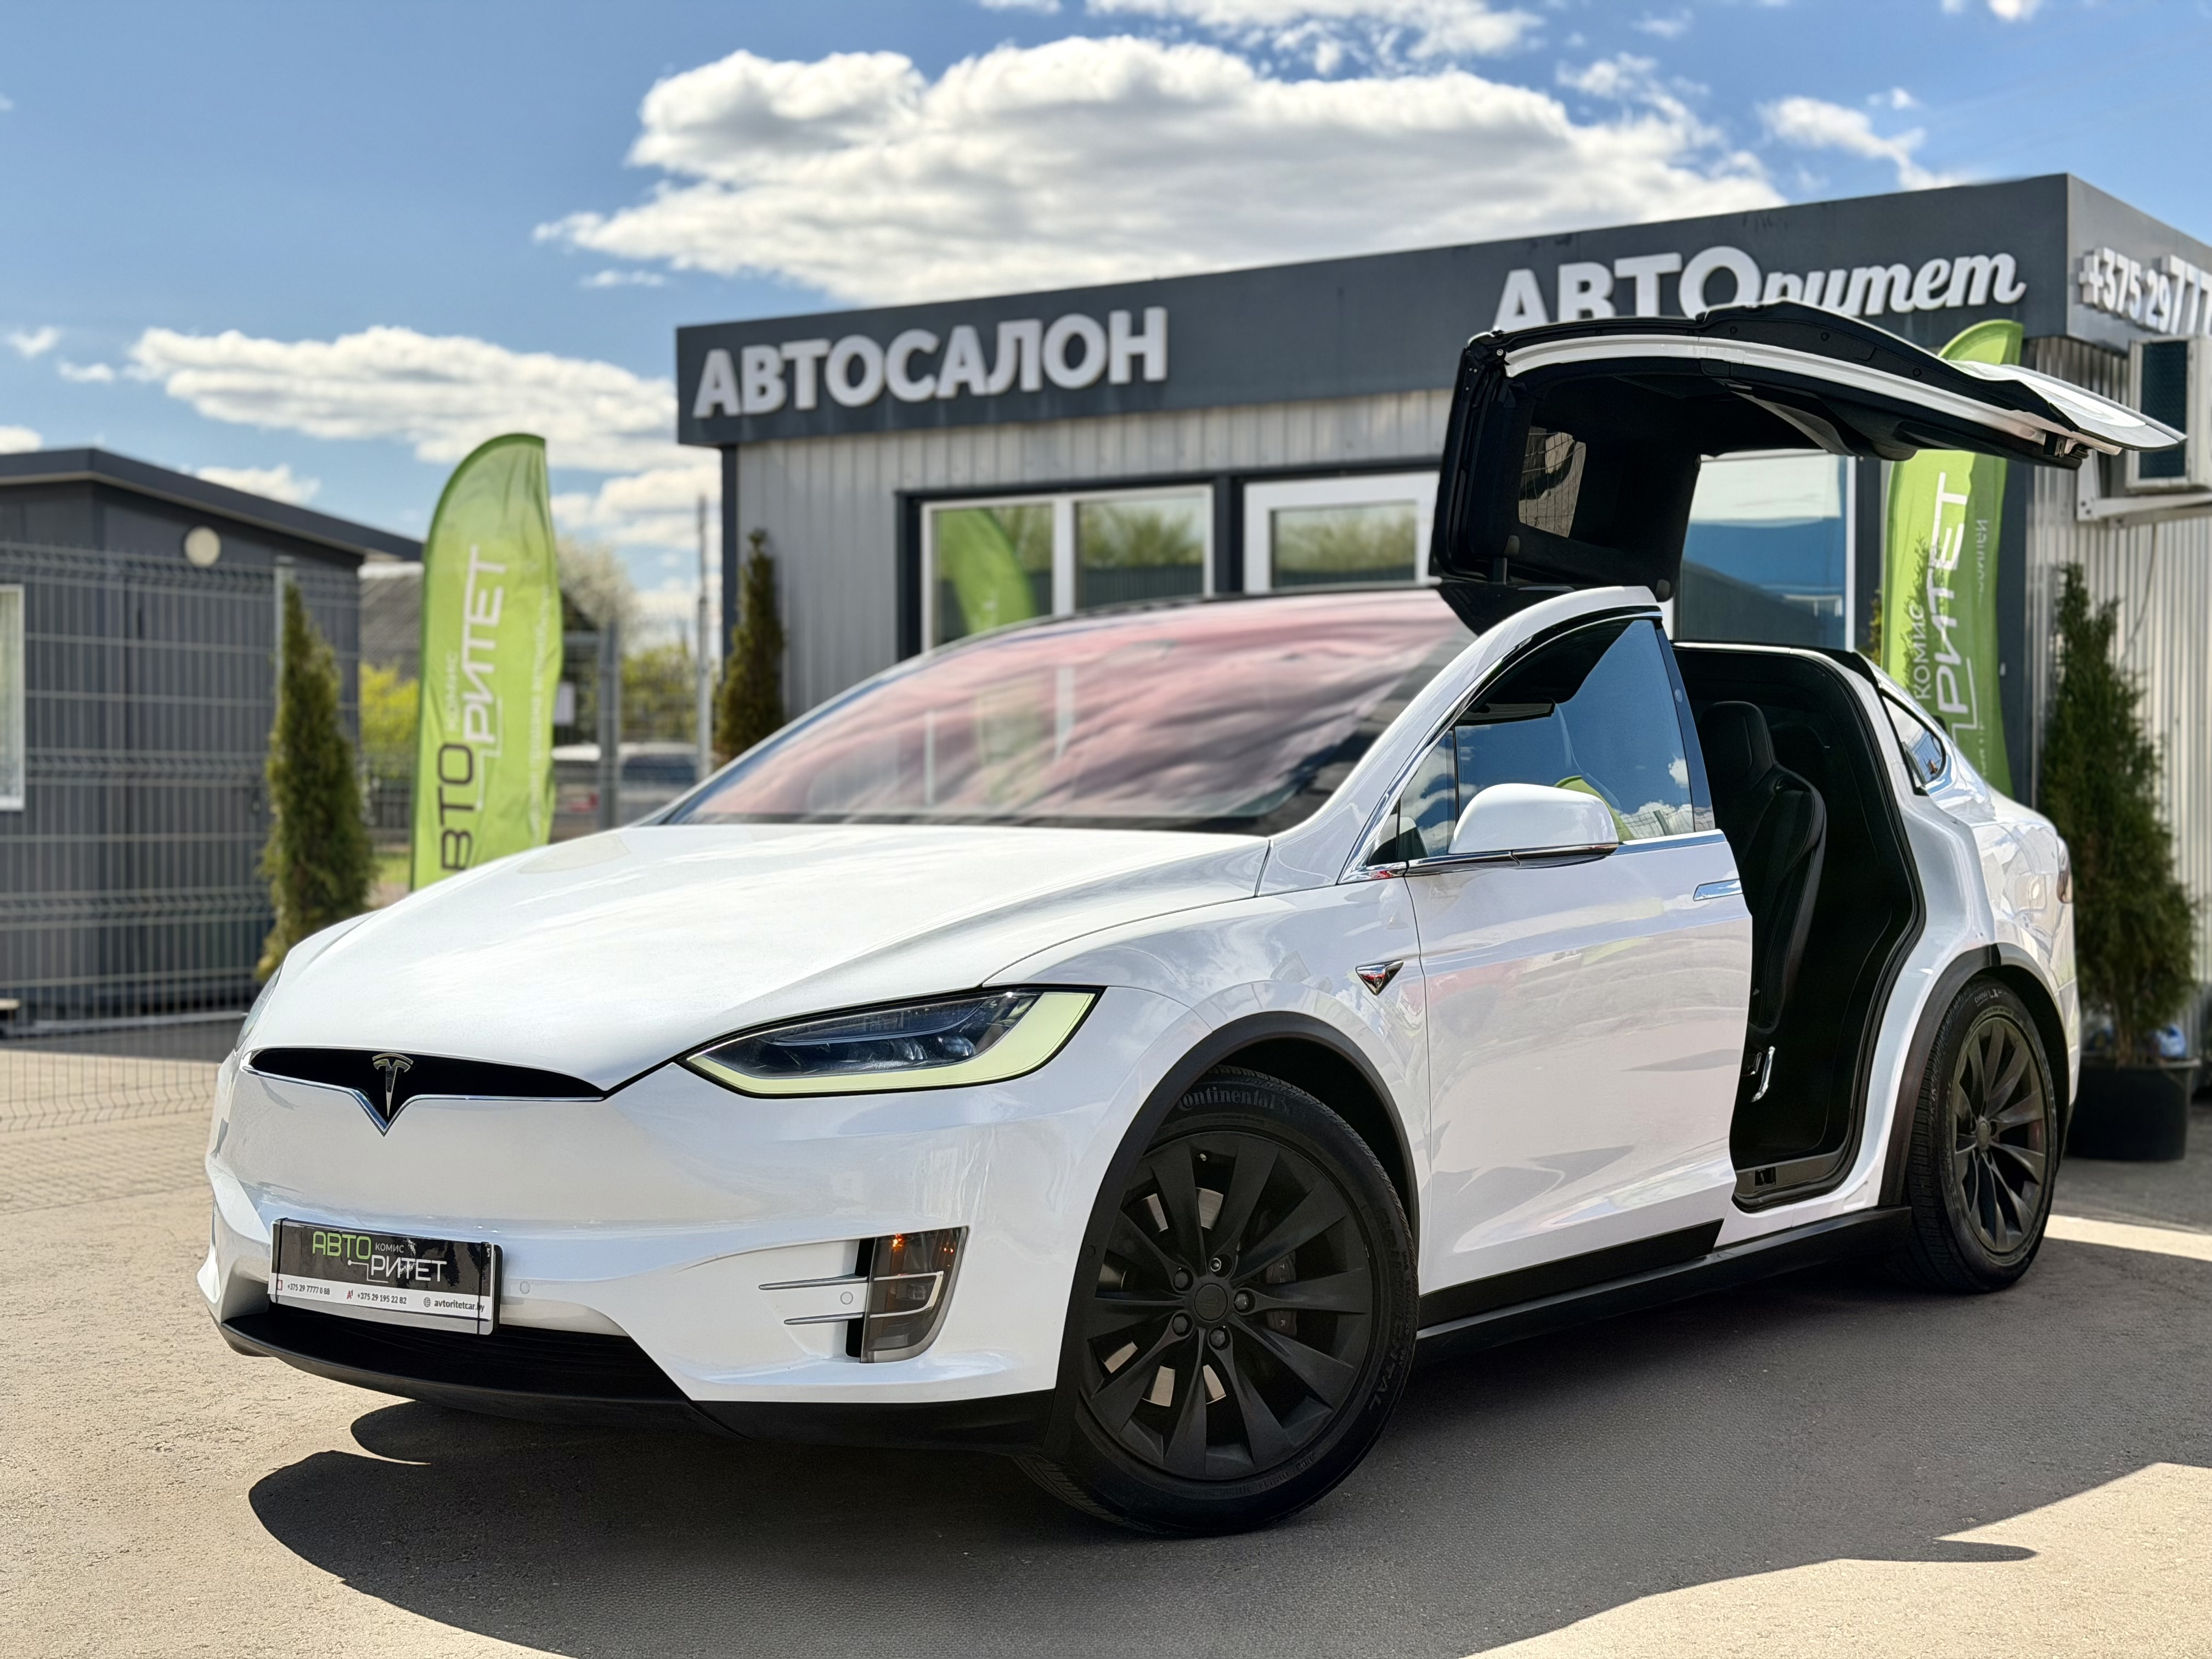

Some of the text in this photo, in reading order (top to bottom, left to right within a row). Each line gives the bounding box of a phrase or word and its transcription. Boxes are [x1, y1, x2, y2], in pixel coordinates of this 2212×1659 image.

[692, 306, 1167, 419] АВТОСАЛОН
[461, 544, 506, 744] РИТЕТ
[1909, 603, 1932, 699] КОМИС
[312, 1231, 371, 1260] АВТО
[375, 1242, 404, 1253] КОМИС
[371, 1255, 447, 1282] РИТЕТ
[287, 1283, 298, 1291] +375
[306, 1285, 319, 1294] 7777
[357, 1292, 370, 1300] +375
[380, 1294, 390, 1302] 195
[391, 1295, 398, 1304] 22
[399, 1296, 407, 1305] 82
